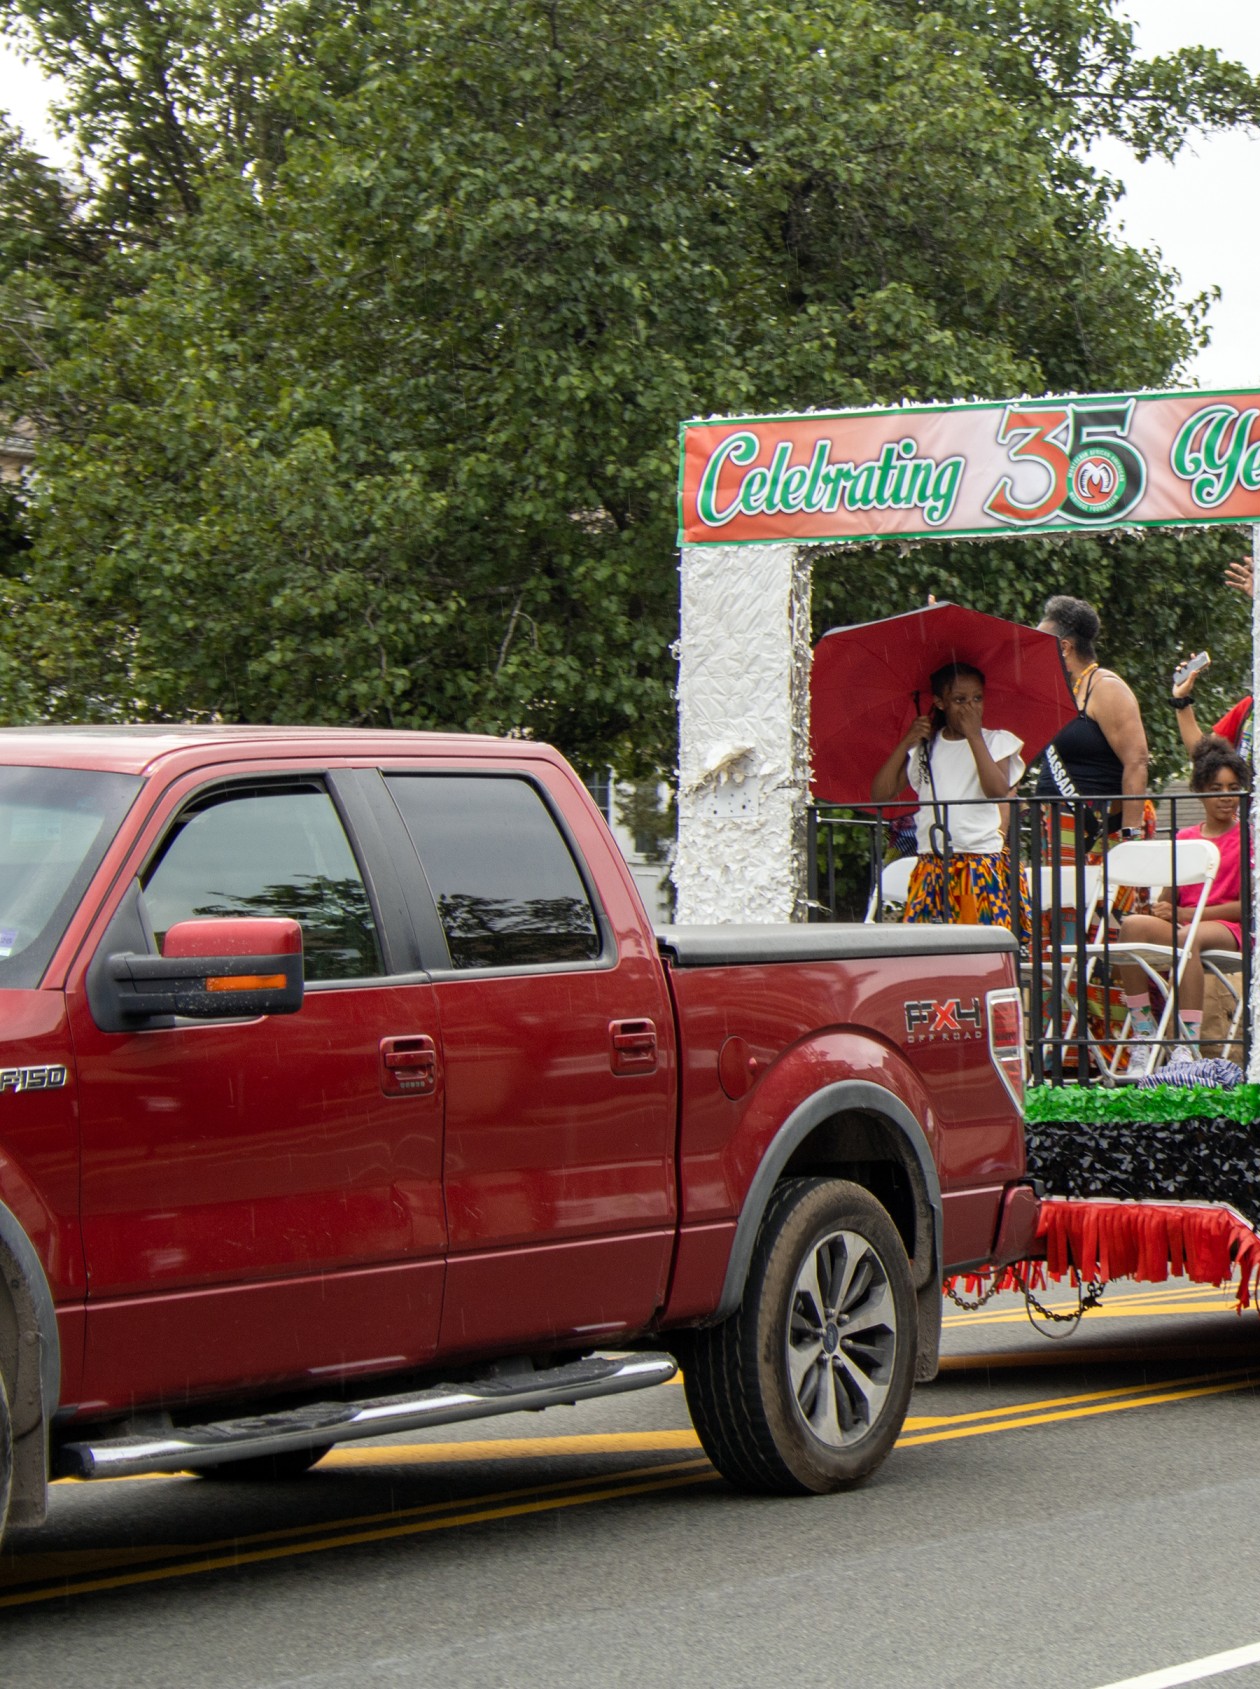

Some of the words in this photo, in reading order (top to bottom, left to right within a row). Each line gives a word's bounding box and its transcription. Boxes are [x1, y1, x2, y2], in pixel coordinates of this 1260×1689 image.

[697, 431, 966, 527] Celebrating
[983, 397, 1148, 525] 35
[904, 997, 982, 1033] FX4
